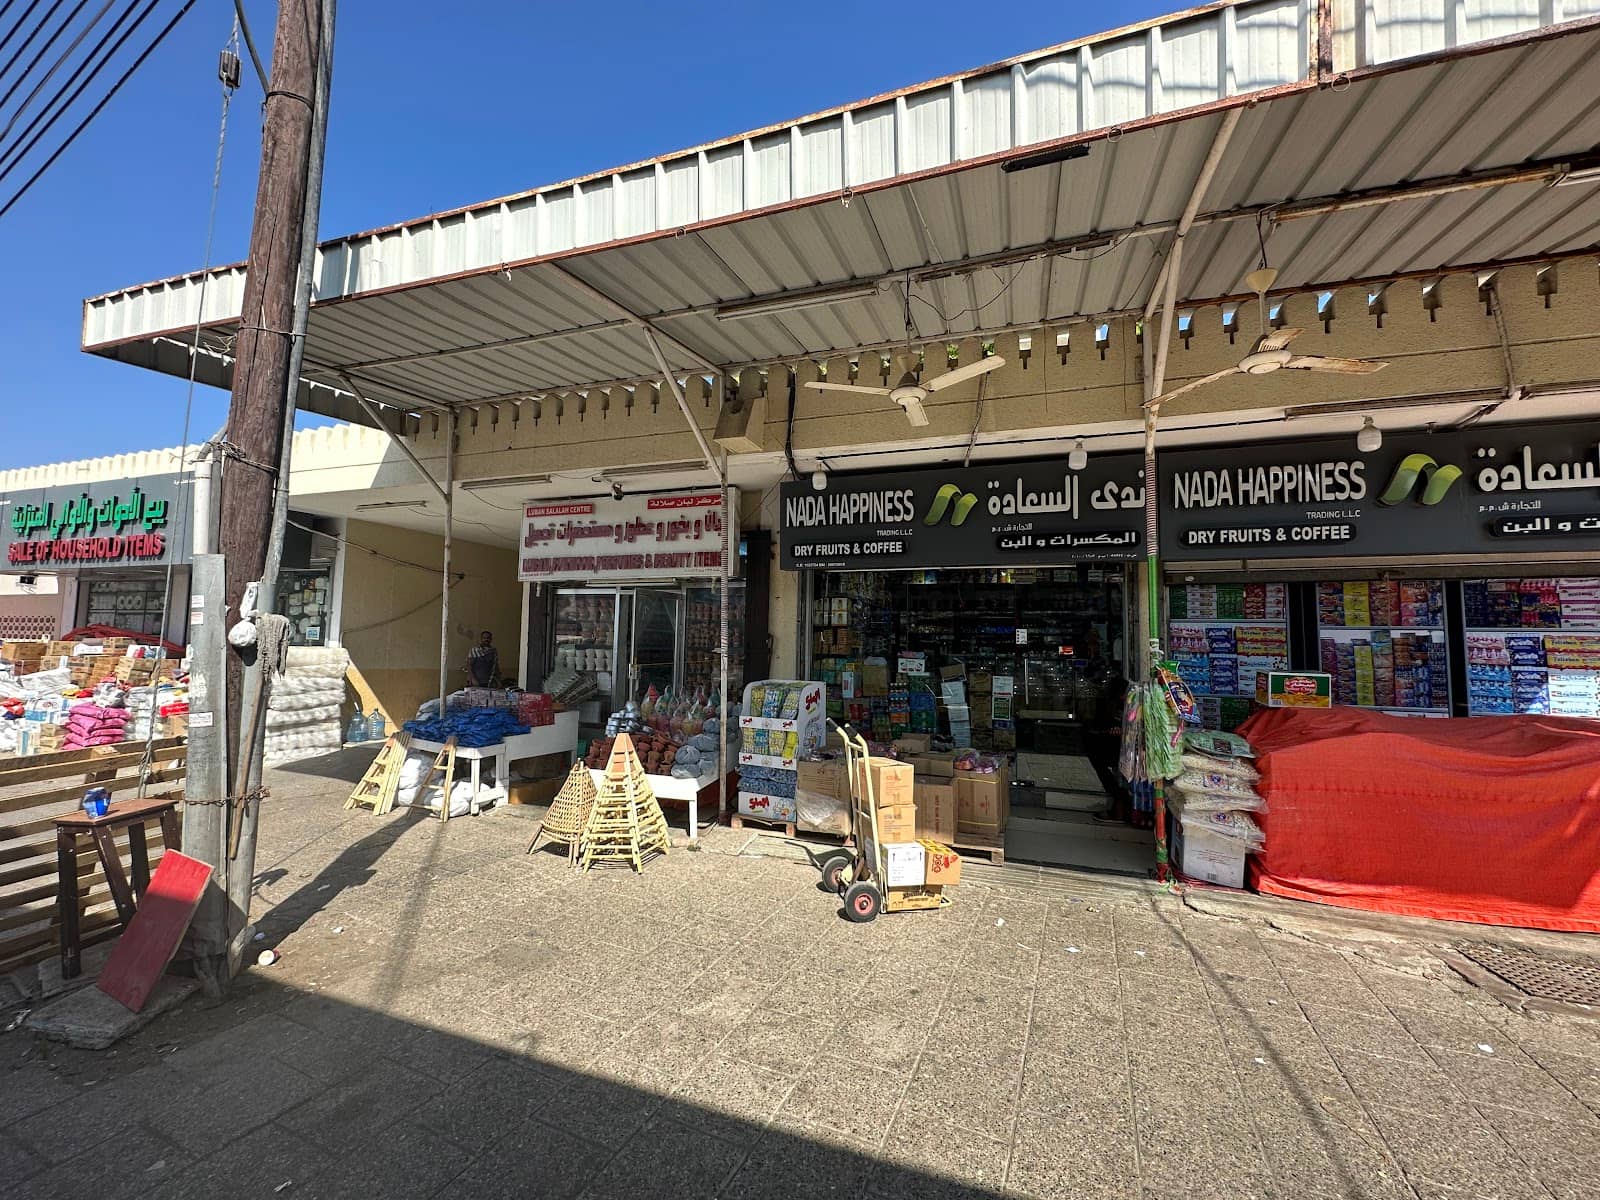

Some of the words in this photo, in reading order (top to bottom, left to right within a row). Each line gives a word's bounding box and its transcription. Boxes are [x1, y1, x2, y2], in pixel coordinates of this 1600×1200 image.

[1478, 442, 1600, 492] لسعادة
[1174, 469, 1233, 509] NADA
[1238, 461, 1367, 506] HAPPINESS
[987, 475, 1079, 519] السعادة
[570, 505, 591, 513] CENTRE
[786, 495, 826, 527] NADA
[829, 489, 914, 525] HAPPINESS
[1306, 510, 1340, 519] TRADING
[704, 510, 721, 537] بان
[1503, 517, 1551, 533] البن
[1001, 535, 1032, 548] البن
[1036, 539, 1046, 547] و
[1050, 532, 1136, 547] المكسرات
[1188, 530, 1216, 544] DRY
[1220, 529, 1271, 543] FRUITS
[1275, 527, 1287, 541] &
[1291, 525, 1350, 541] COFFEE
[8, 541, 34, 561] SALE
[36, 540, 50, 560] OF
[51, 535, 122, 560] HOUSEHOLD
[124, 533, 163, 557] ITEMS
[794, 545, 813, 556] DRY
[815, 543, 850, 556] FRUITS
[853, 543, 860, 554] &
[863, 541, 902, 554] COFFEE
